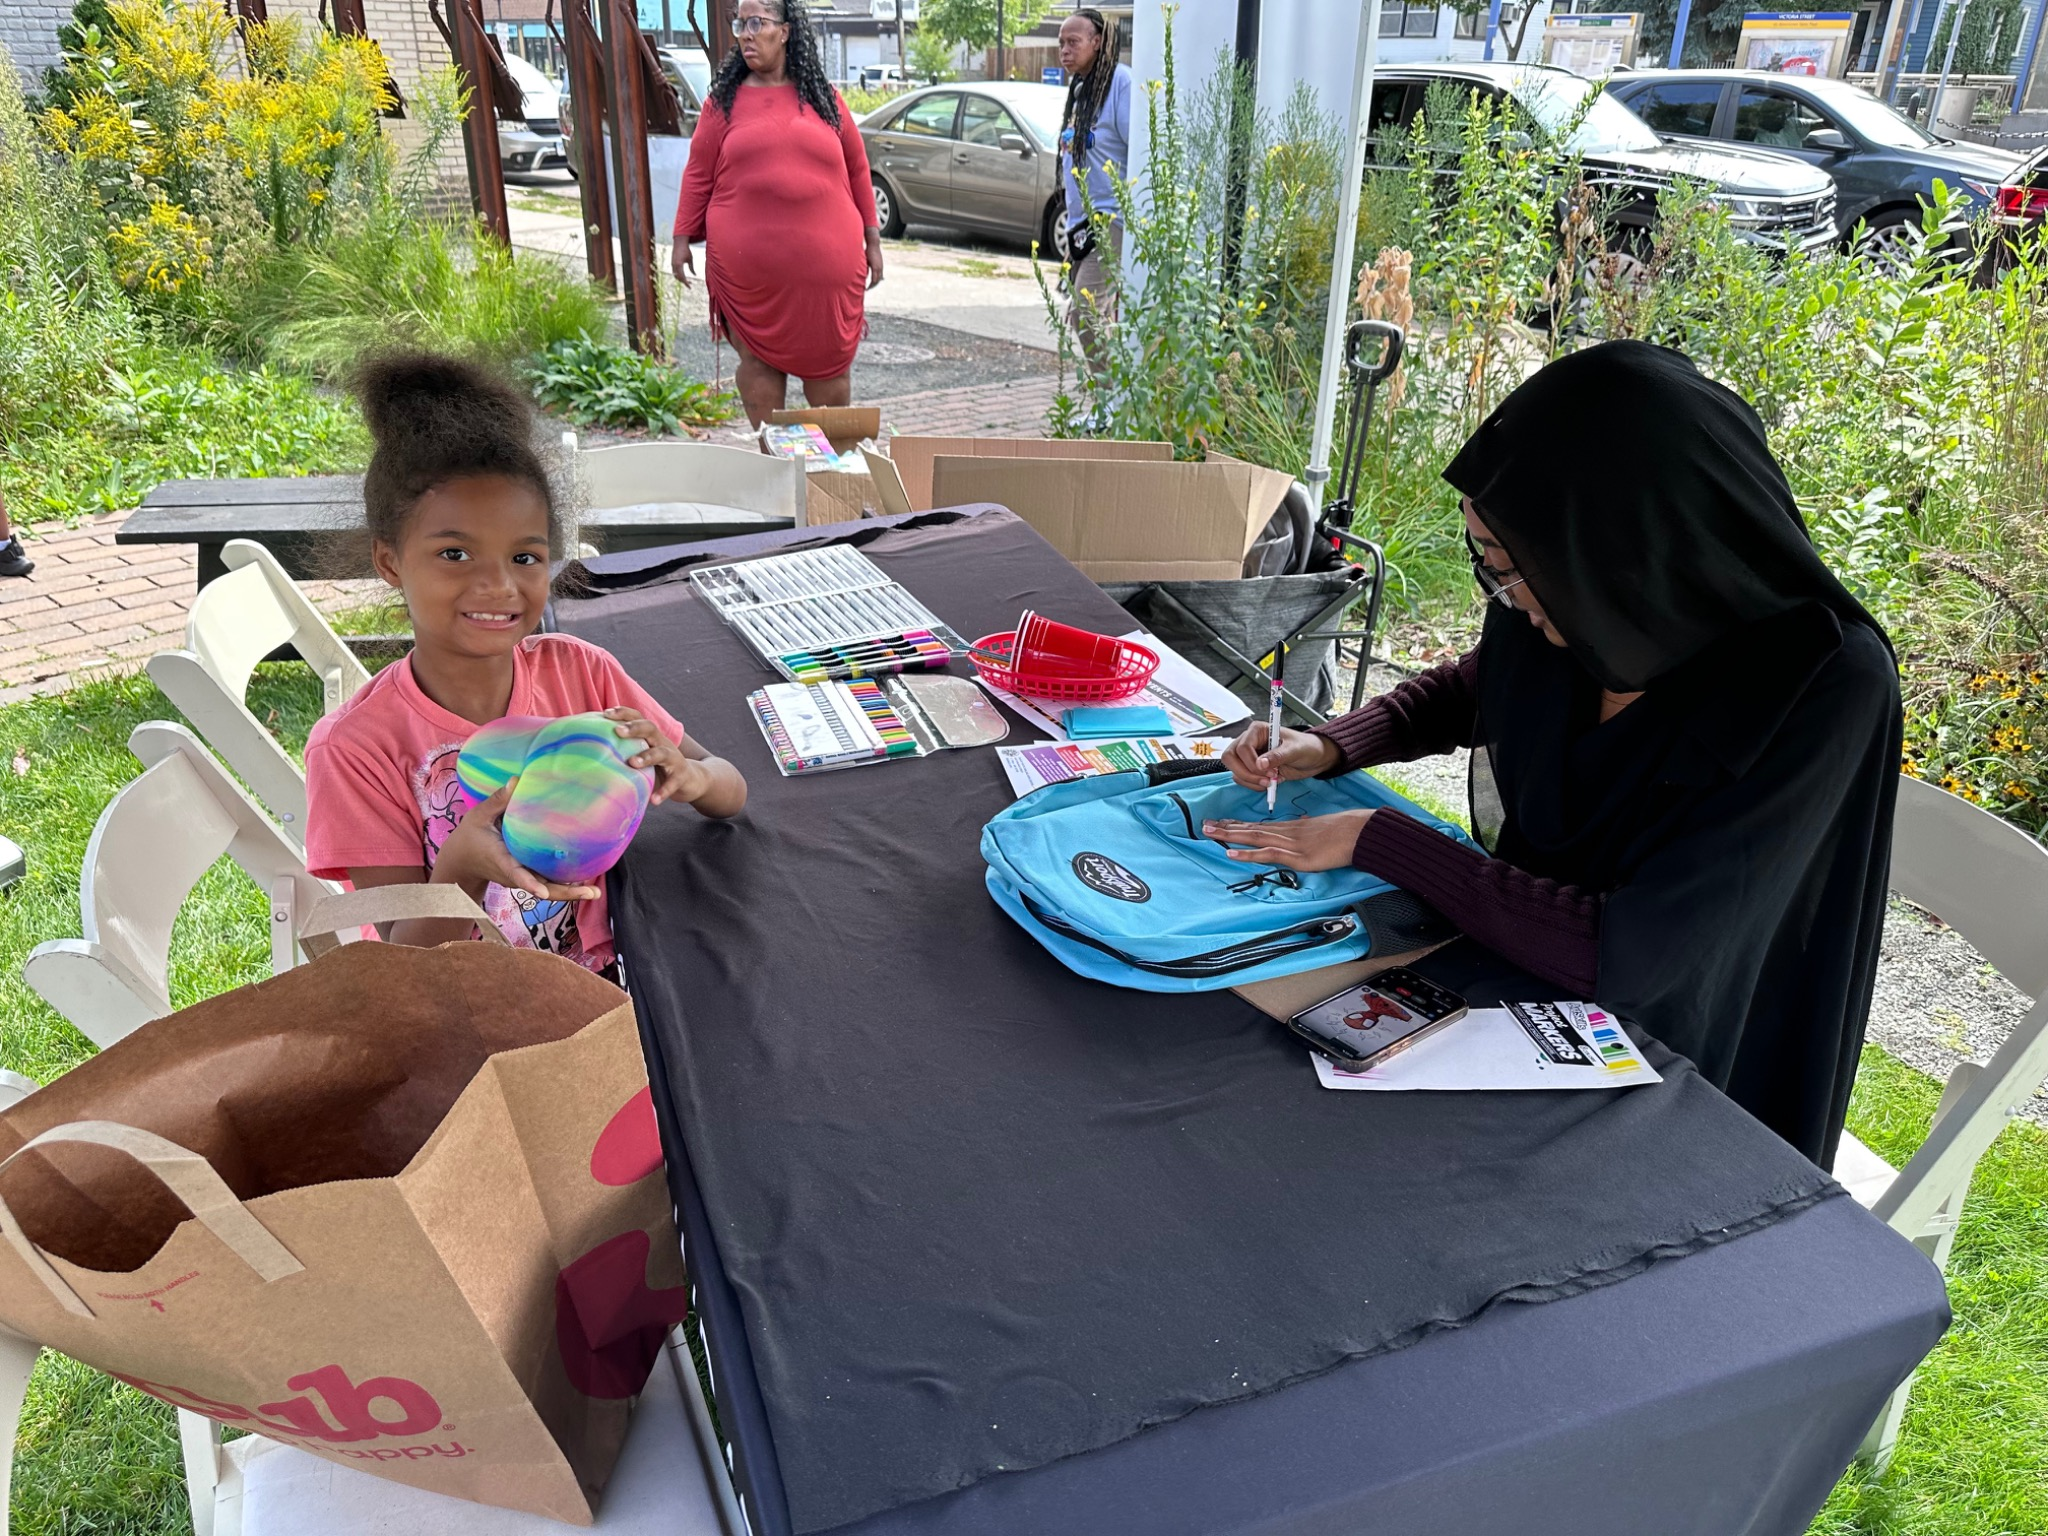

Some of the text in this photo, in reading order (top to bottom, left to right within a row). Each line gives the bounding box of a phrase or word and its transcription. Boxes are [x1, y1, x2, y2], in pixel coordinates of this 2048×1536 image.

[1147, 683, 1173, 699] VENTS
[1540, 1003, 1569, 1029] Project
[1519, 1002, 1583, 1060] MARKERS
[164, 1270, 200, 1291] HANDLES
